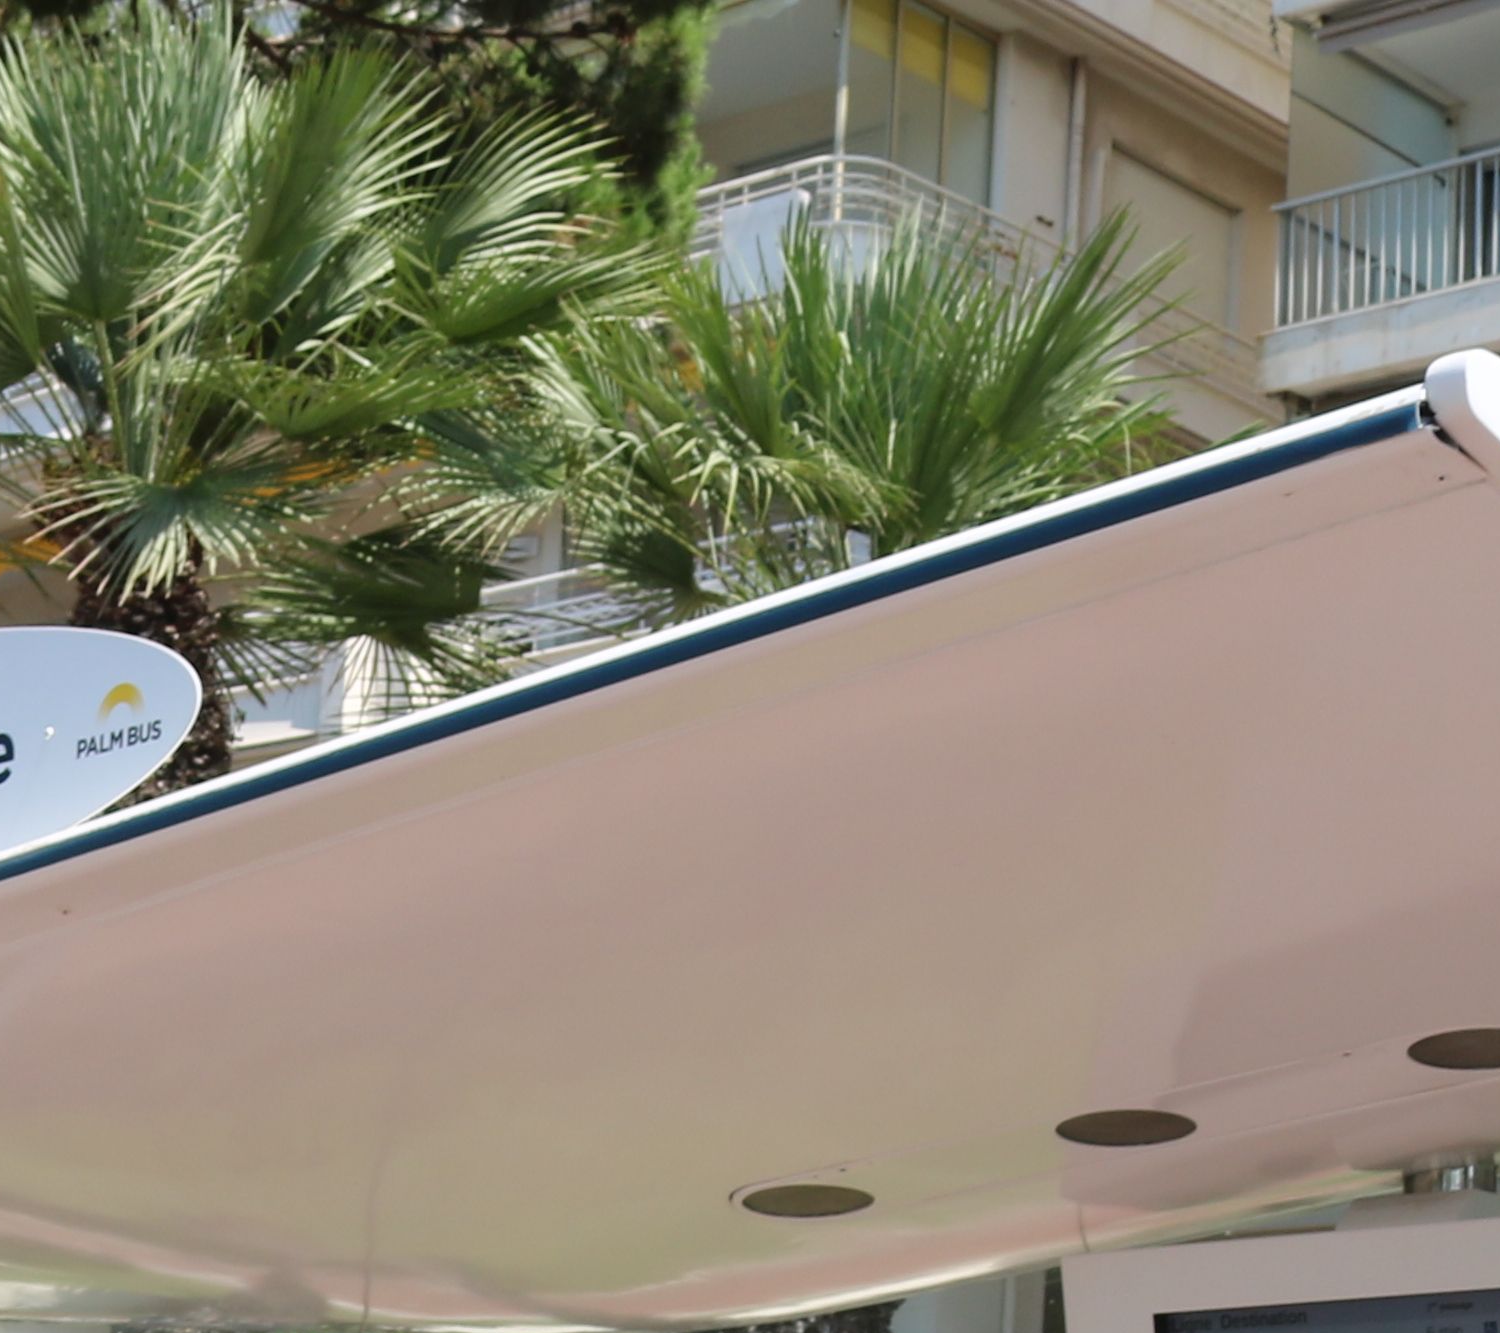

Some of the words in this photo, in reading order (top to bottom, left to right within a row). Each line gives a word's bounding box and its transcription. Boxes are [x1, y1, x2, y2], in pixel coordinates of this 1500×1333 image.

[76, 728, 123, 760] PALM
[125, 718, 162, 747] BUS
[1220, 1310, 1307, 1329] Destination
